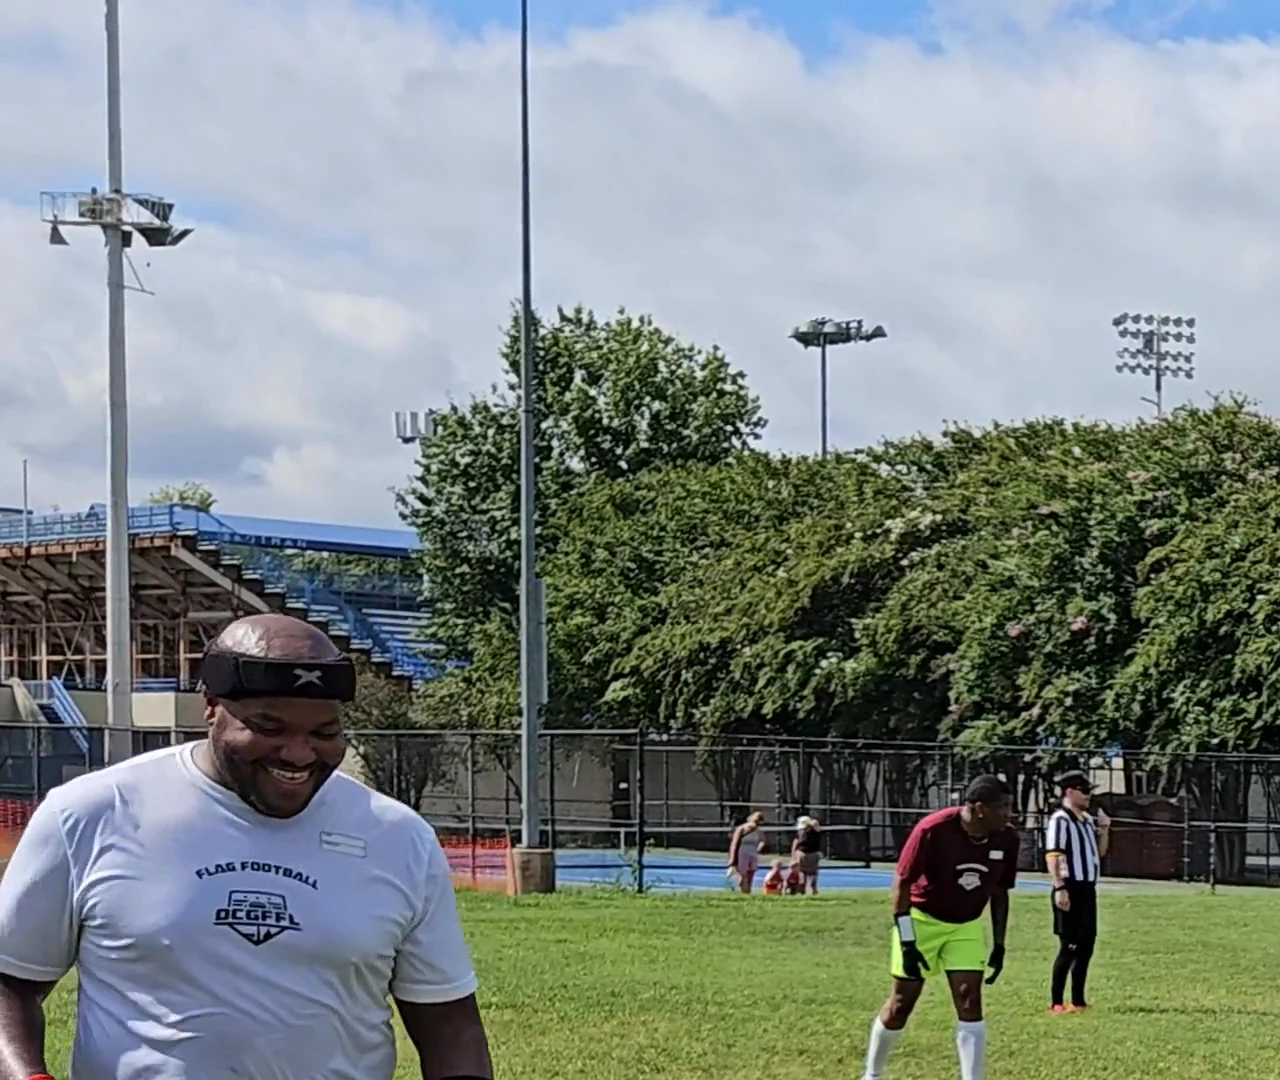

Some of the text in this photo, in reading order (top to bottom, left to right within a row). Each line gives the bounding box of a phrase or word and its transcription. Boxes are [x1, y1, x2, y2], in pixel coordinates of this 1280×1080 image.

[195, 861, 319, 890] FLAG FOOTBALL
[215, 908, 300, 927] DCGFFL
